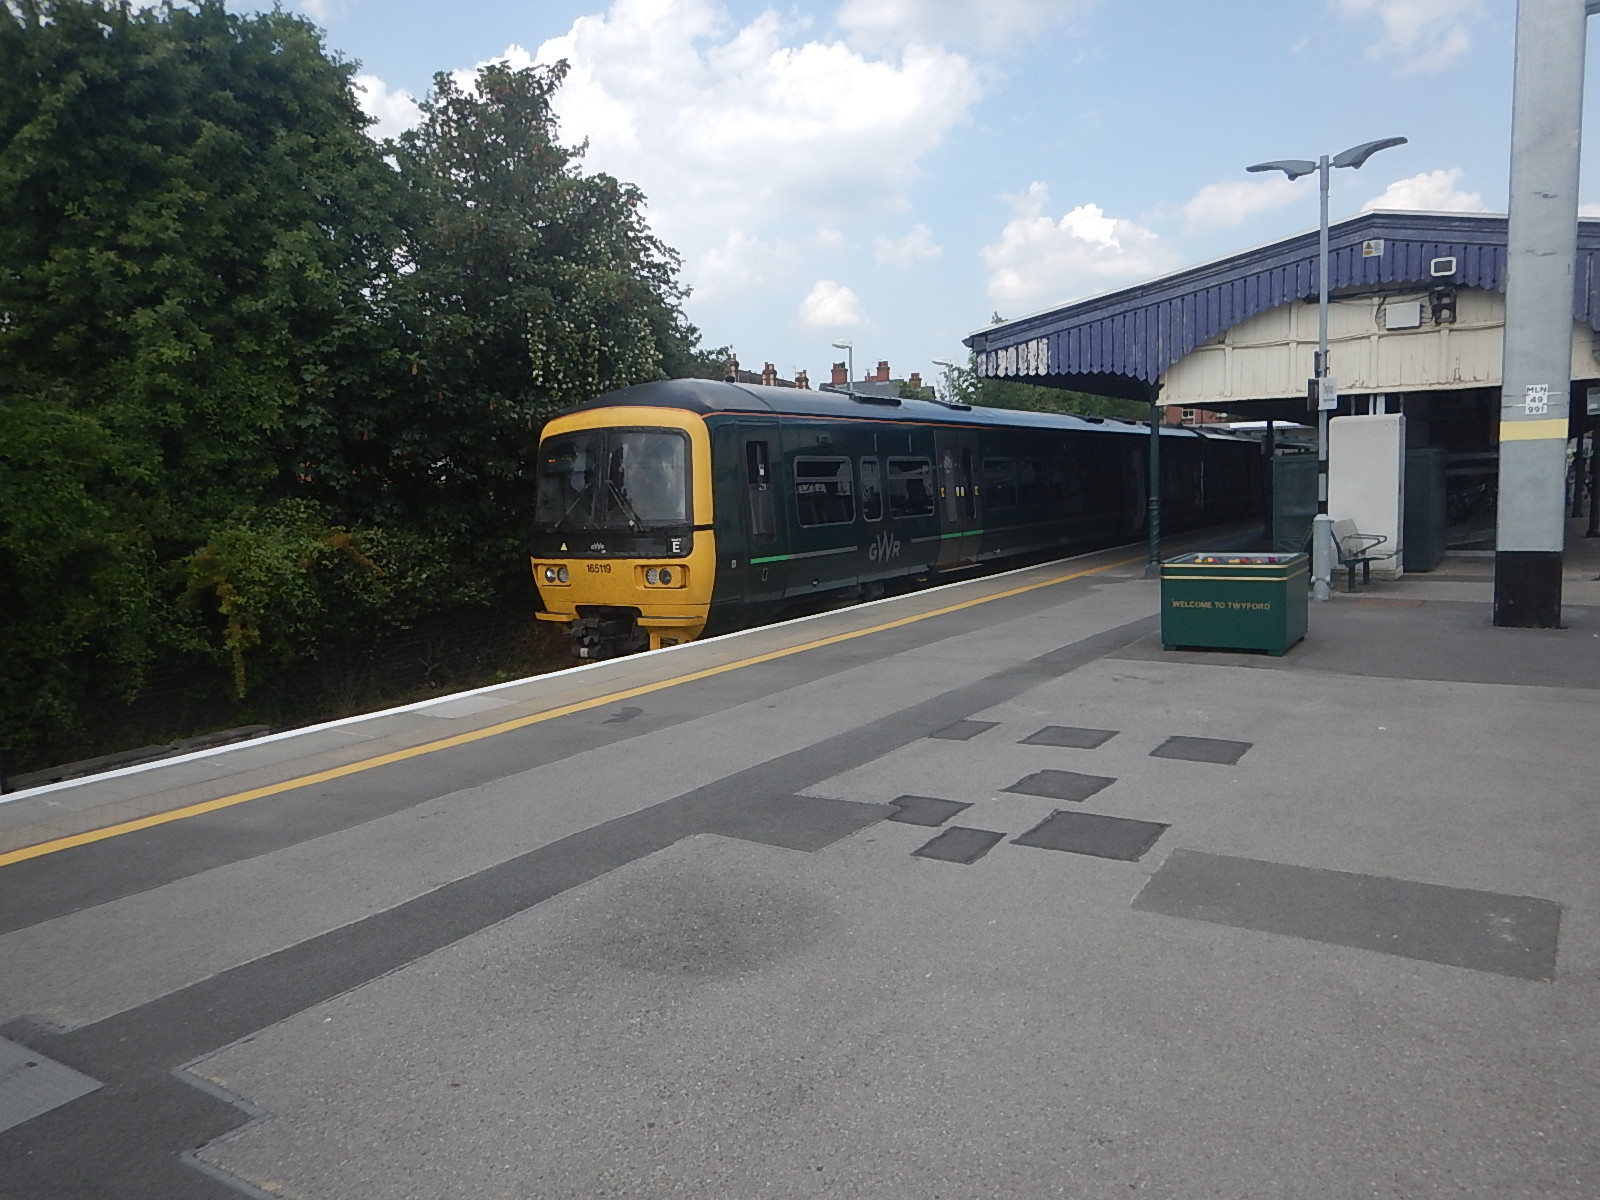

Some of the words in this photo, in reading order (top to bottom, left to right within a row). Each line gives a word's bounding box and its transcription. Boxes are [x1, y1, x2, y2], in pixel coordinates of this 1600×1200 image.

[1526, 386, 1547, 394] MLN
[1527, 405, 1545, 413] 991
[672, 541, 680, 553] E
[869, 530, 900, 564] GWR
[587, 563, 611, 573] 165119
[1172, 600, 1212, 609] WELCOME
[1215, 601, 1225, 609] TO
[1228, 601, 1270, 610] TWYFORD
